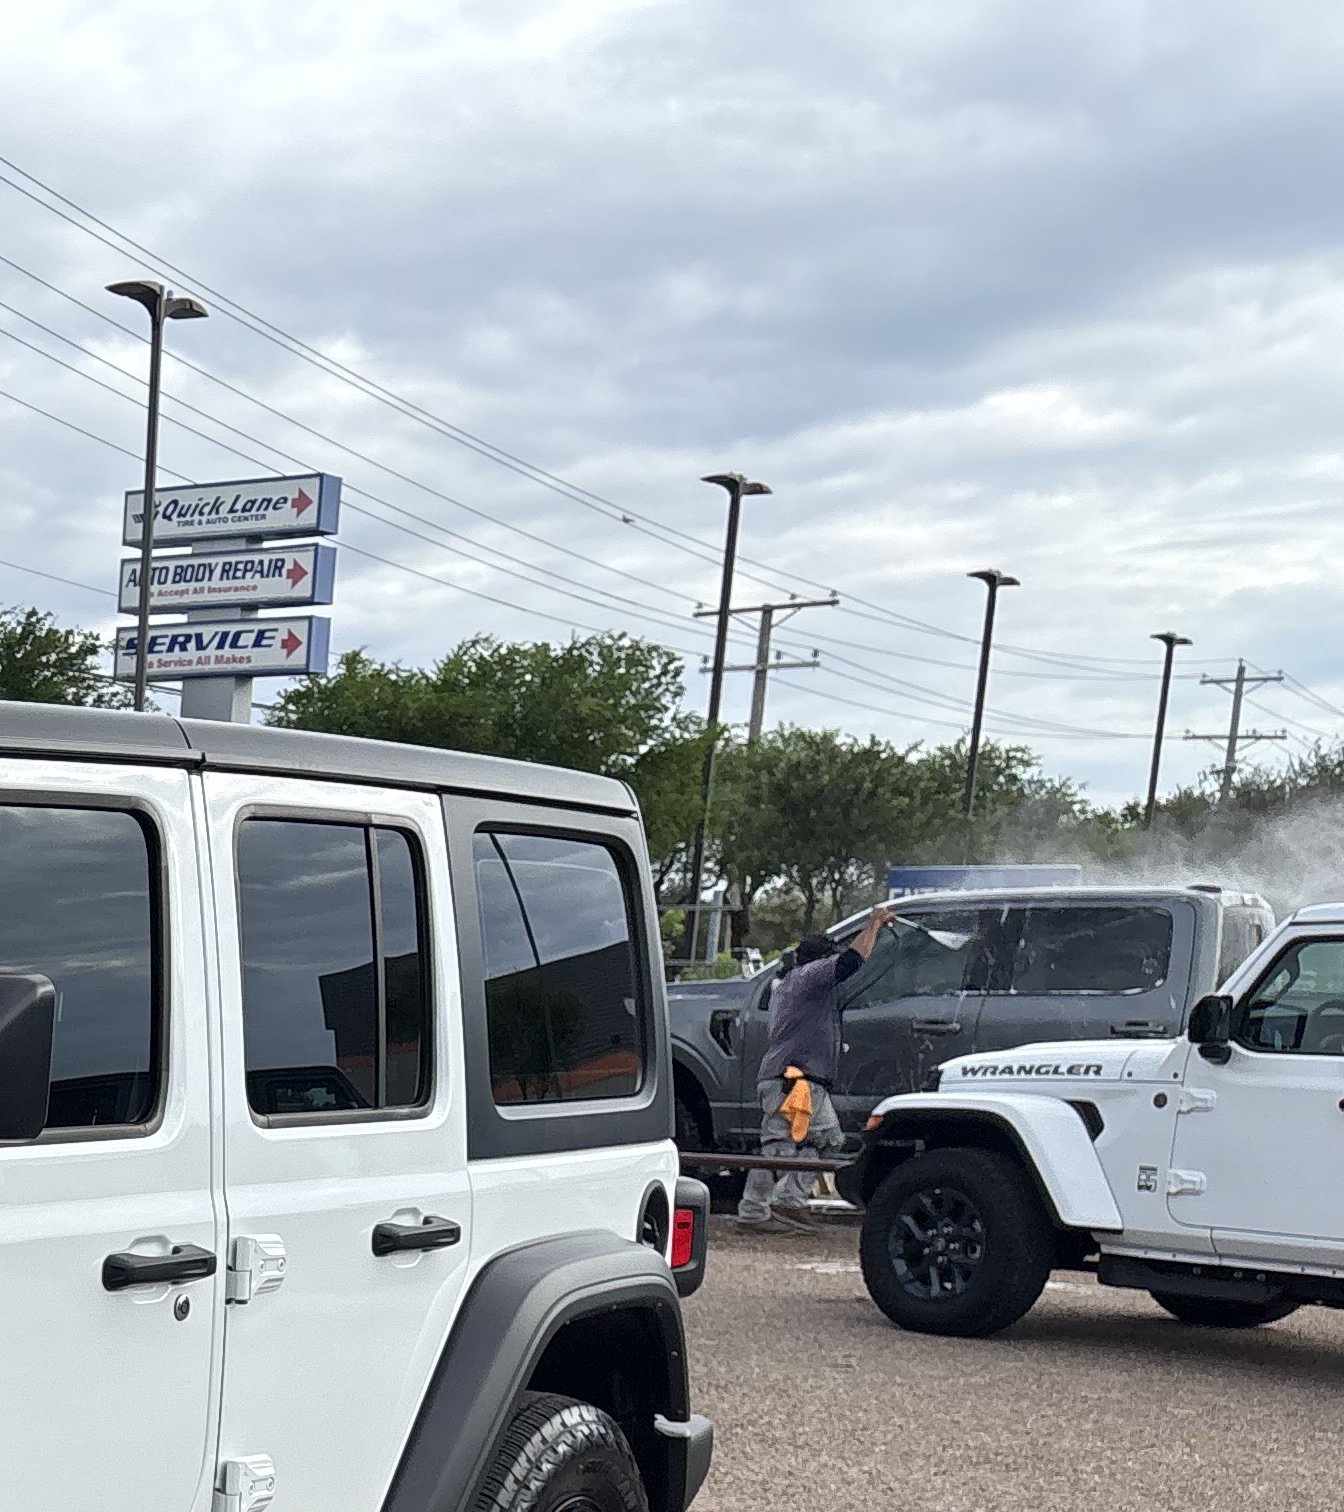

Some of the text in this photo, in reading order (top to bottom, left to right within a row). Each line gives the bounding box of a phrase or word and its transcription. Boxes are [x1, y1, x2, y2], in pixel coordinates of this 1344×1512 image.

[162, 493, 289, 521] Quick Lane
[176, 519, 195, 527] TIRE
[205, 516, 229, 525] AUTO
[231, 513, 267, 524] CENTER
[125, 557, 286, 588] ATO BODY REPAIR
[157, 586, 190, 598] Accept
[192, 585, 206, 594] All
[208, 583, 258, 594] Insurance
[156, 657, 194, 668] Service
[196, 655, 210, 666] All
[213, 654, 252, 665] Makes
[961, 1063, 1103, 1077] WRANGLER
